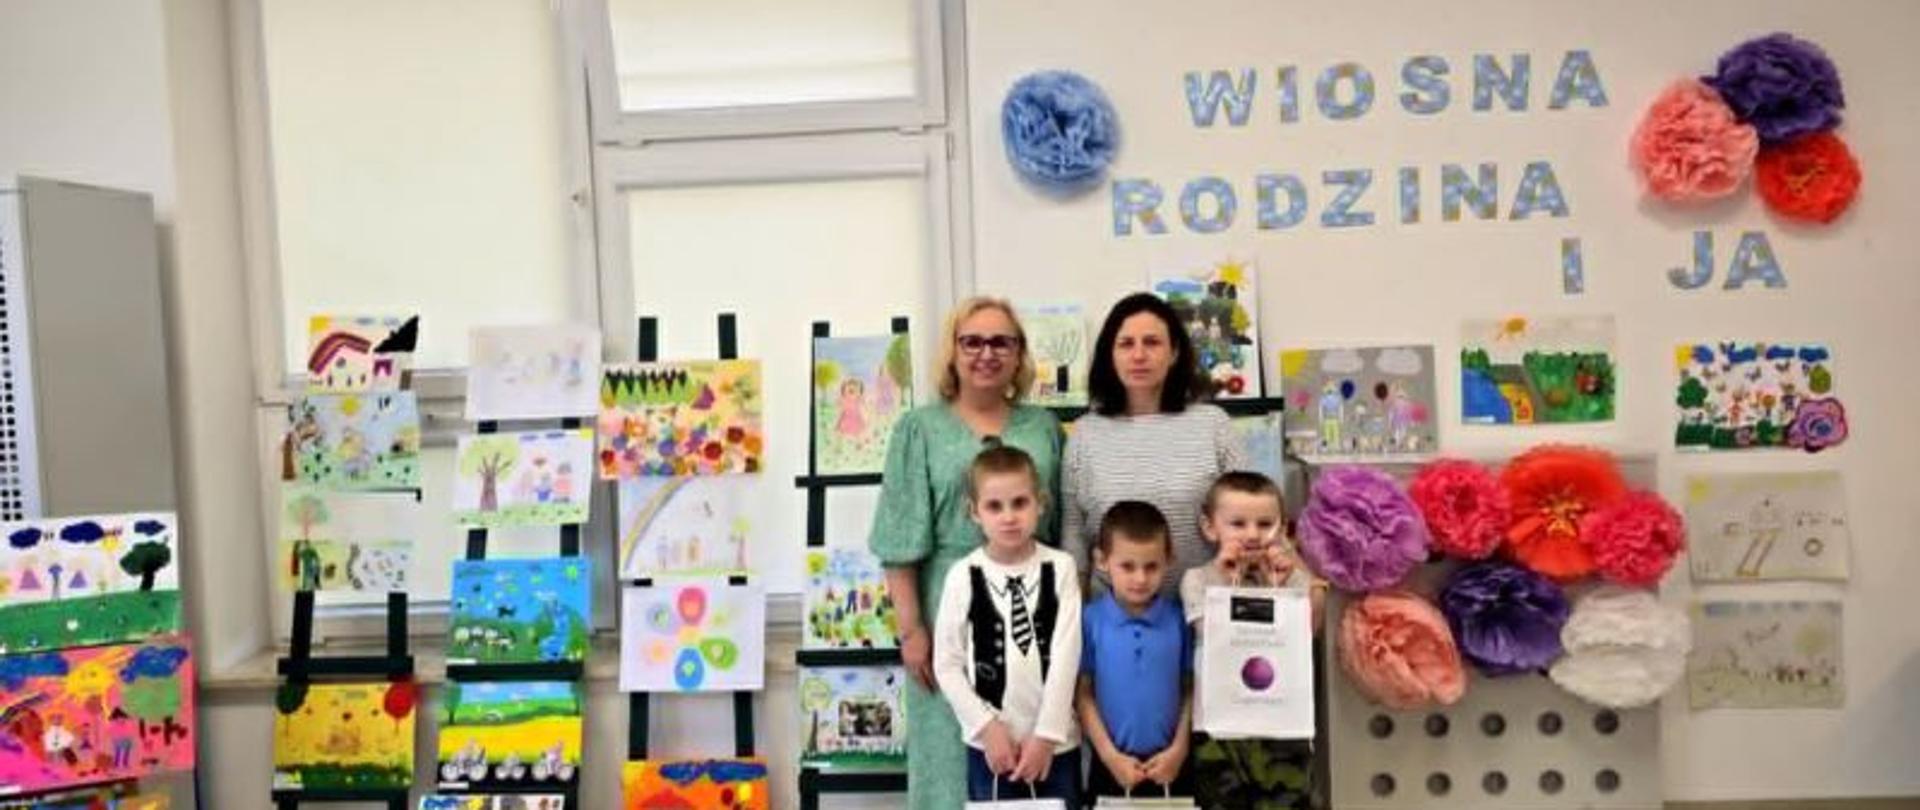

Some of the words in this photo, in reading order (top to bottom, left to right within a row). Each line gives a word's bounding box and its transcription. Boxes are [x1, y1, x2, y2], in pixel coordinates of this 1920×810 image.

[1184, 51, 1609, 127] WIOSNA
[1112, 161, 1570, 236] RODZINA
[1561, 238, 1584, 294] I
[1667, 230, 1787, 290] JA
